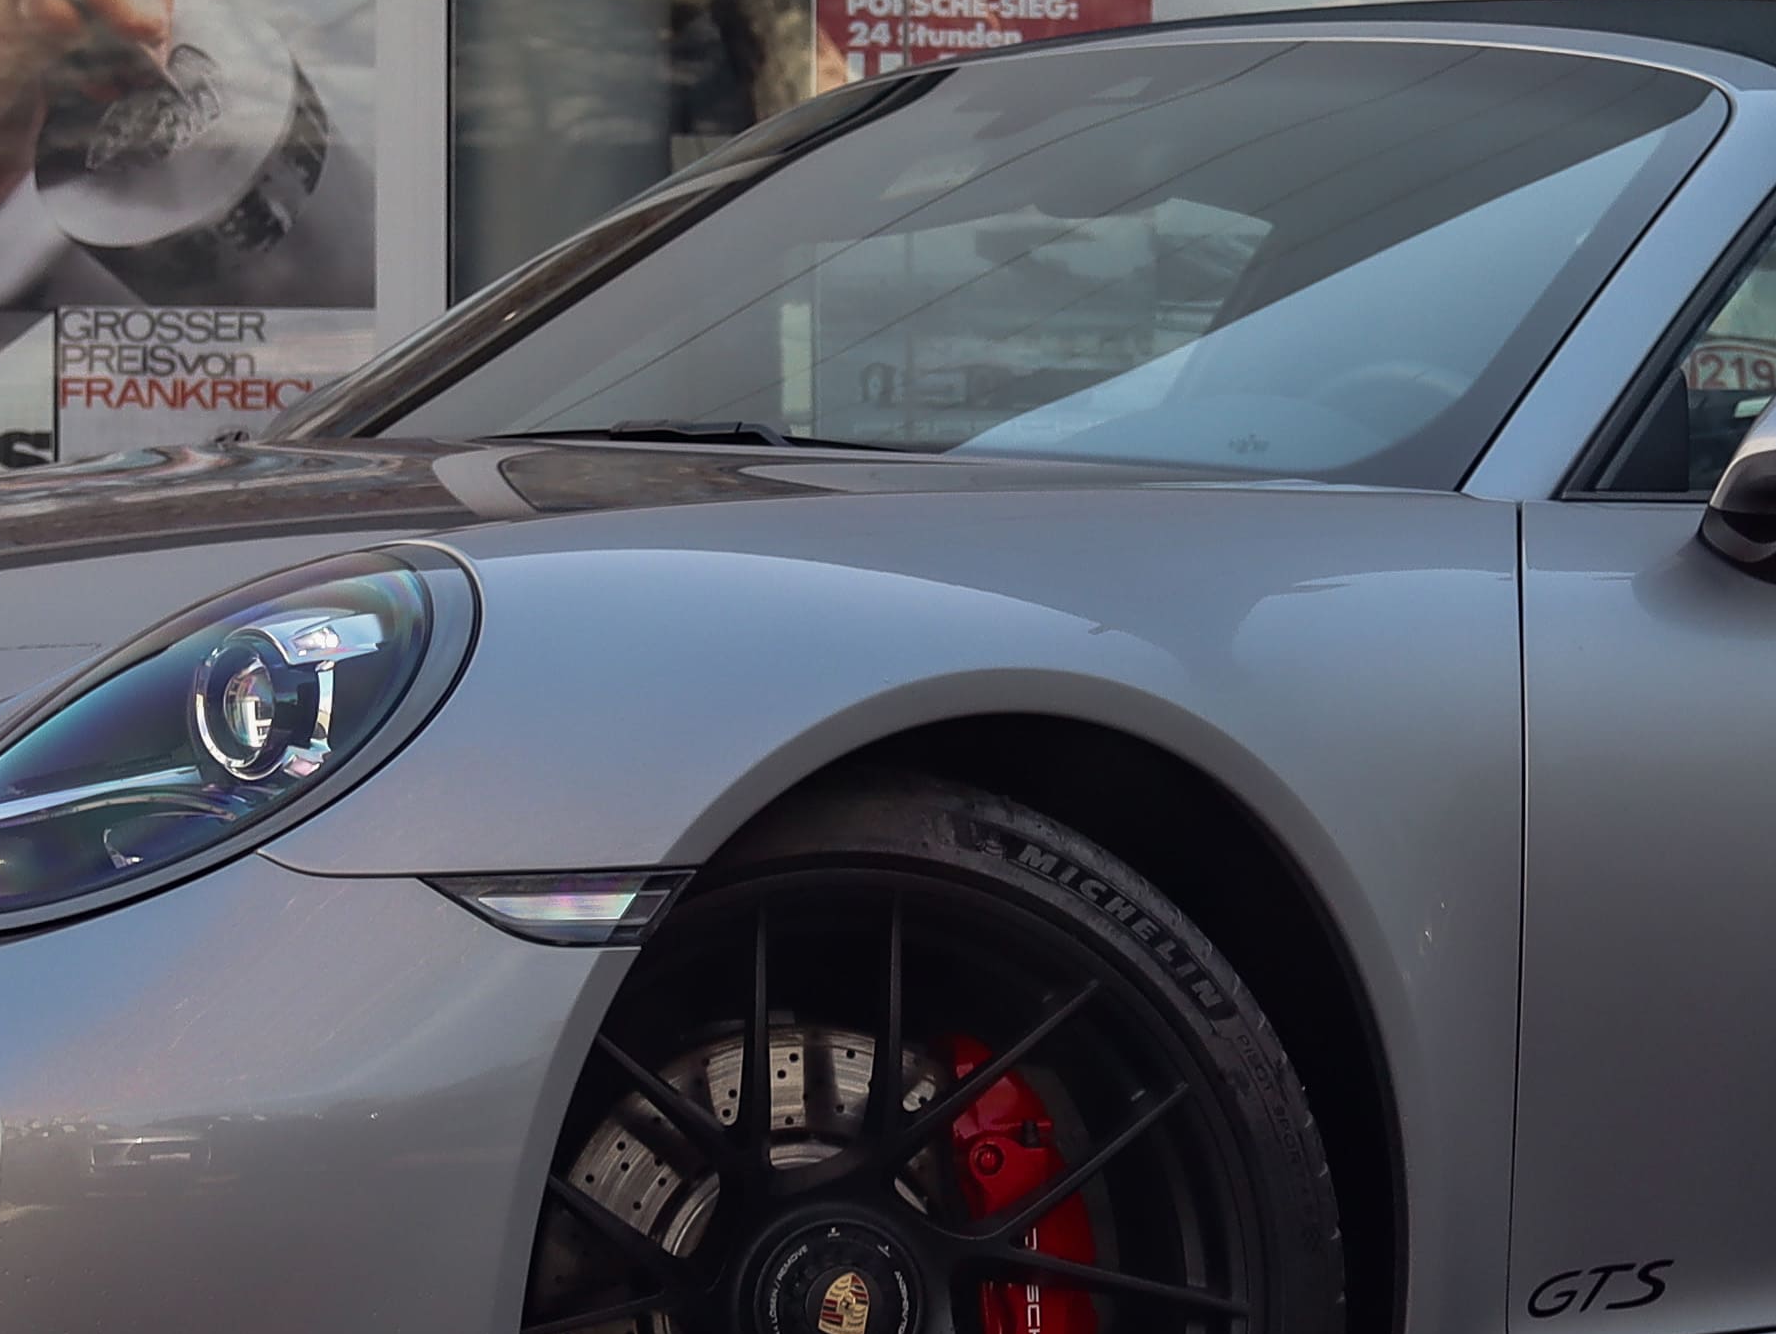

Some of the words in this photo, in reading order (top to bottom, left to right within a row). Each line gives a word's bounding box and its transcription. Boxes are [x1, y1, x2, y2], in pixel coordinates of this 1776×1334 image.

[848, 21, 891, 47] 24
[898, 22, 1023, 48] Stunden
[60, 310, 267, 344] GROSSER
[1699, 353, 1776, 389] 219
[60, 378, 312, 411] FRANKREIC
[1016, 842, 1225, 1009] MICHELIN
[1527, 1259, 1675, 1319] GTS
